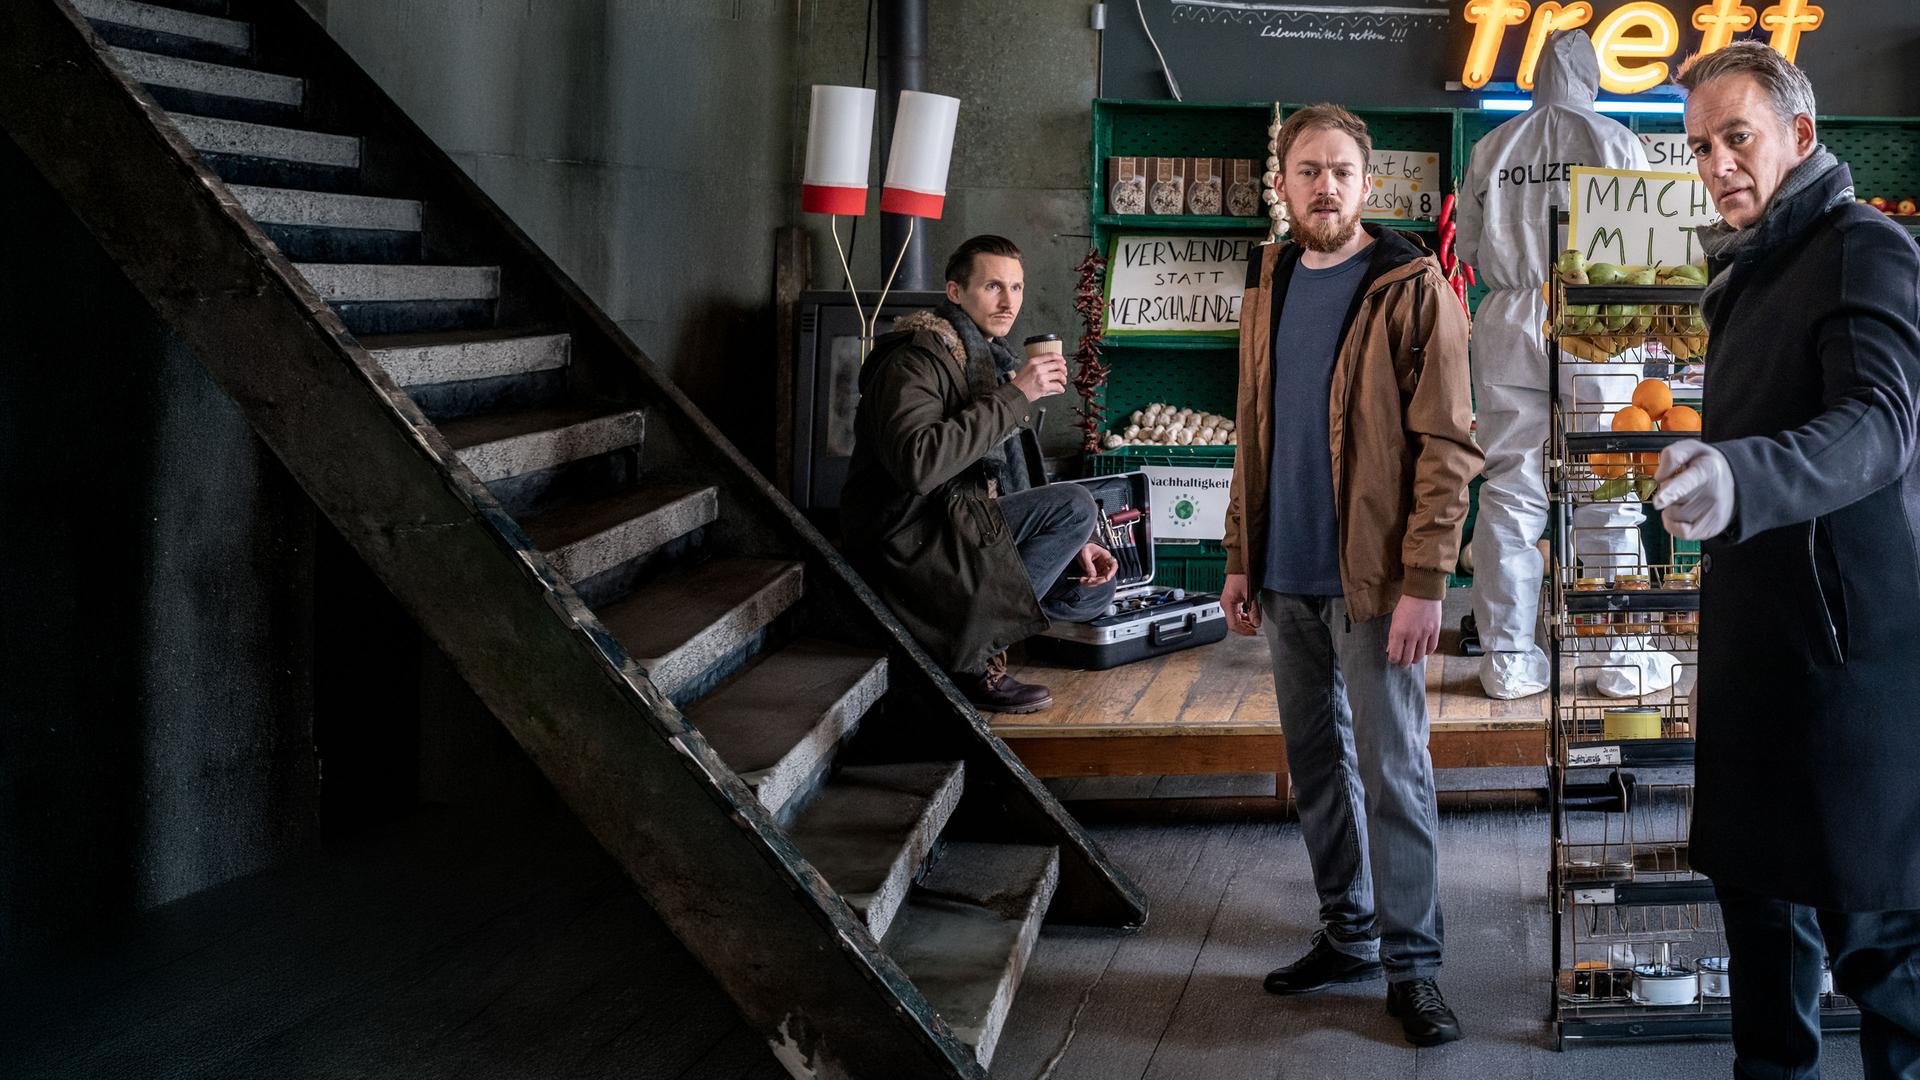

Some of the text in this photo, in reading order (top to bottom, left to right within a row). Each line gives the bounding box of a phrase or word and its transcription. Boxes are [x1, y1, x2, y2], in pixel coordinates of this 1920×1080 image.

[1349, 28, 1386, 41] retten
[1403, 156, 1424, 179] be
[1498, 162, 1584, 188] POLIZE
[1420, 193, 1432, 213] 8
[1587, 176, 1707, 217] MACH
[1587, 226, 1697, 266] MIT
[1155, 271, 1224, 286] STATT
[1111, 294, 1244, 325] VERSCHWENDE
